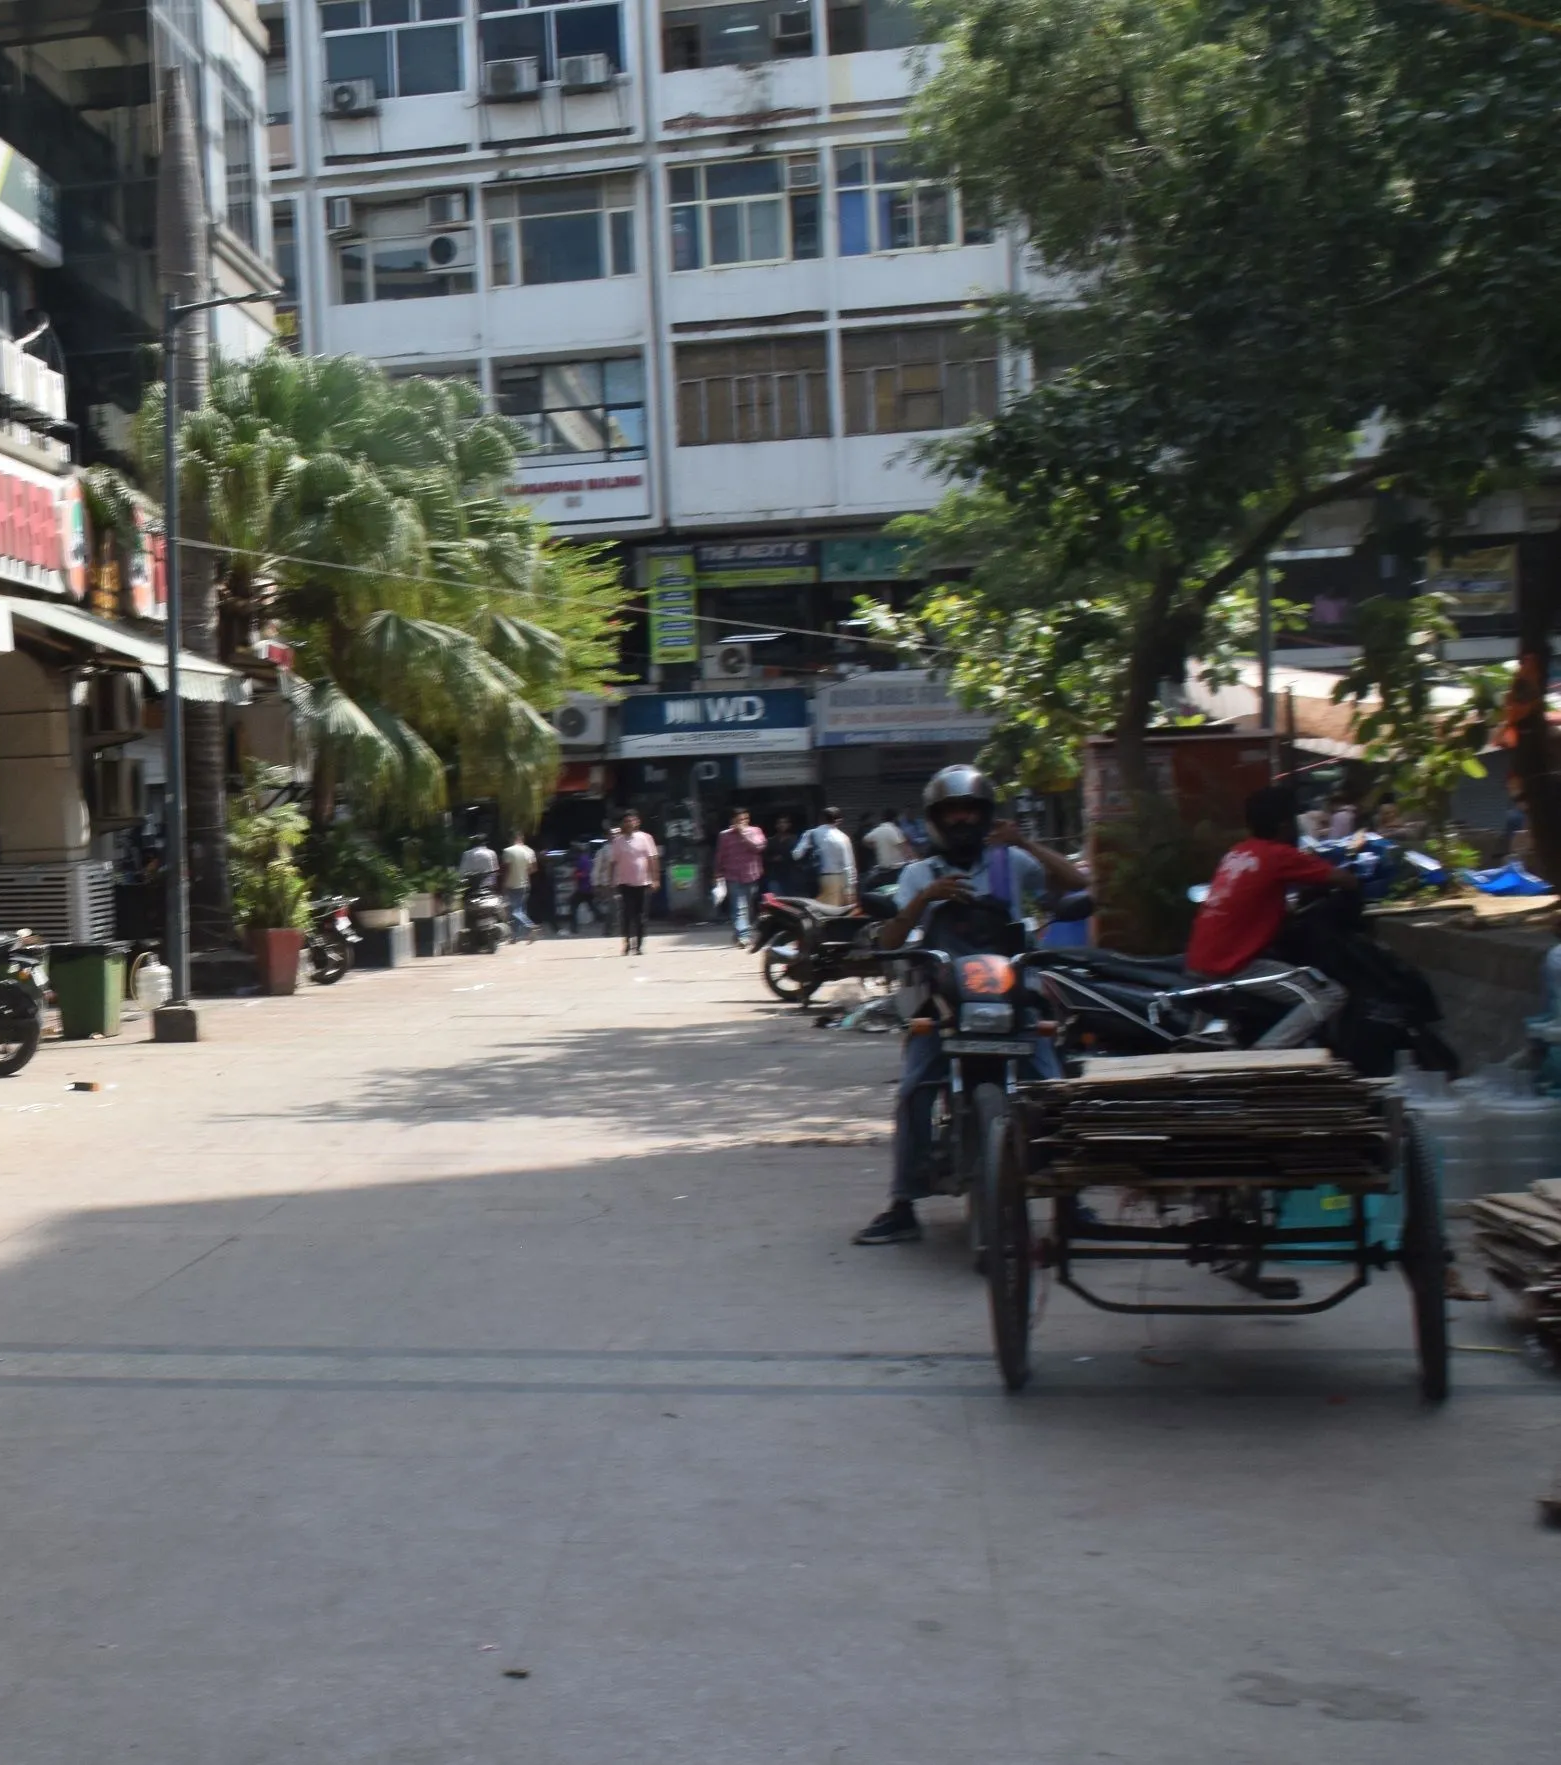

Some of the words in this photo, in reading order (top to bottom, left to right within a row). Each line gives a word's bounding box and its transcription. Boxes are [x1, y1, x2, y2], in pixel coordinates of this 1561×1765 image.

[700, 545, 737, 560] THE
[740, 543, 791, 558] NEXT
[704, 696, 766, 722] WD
